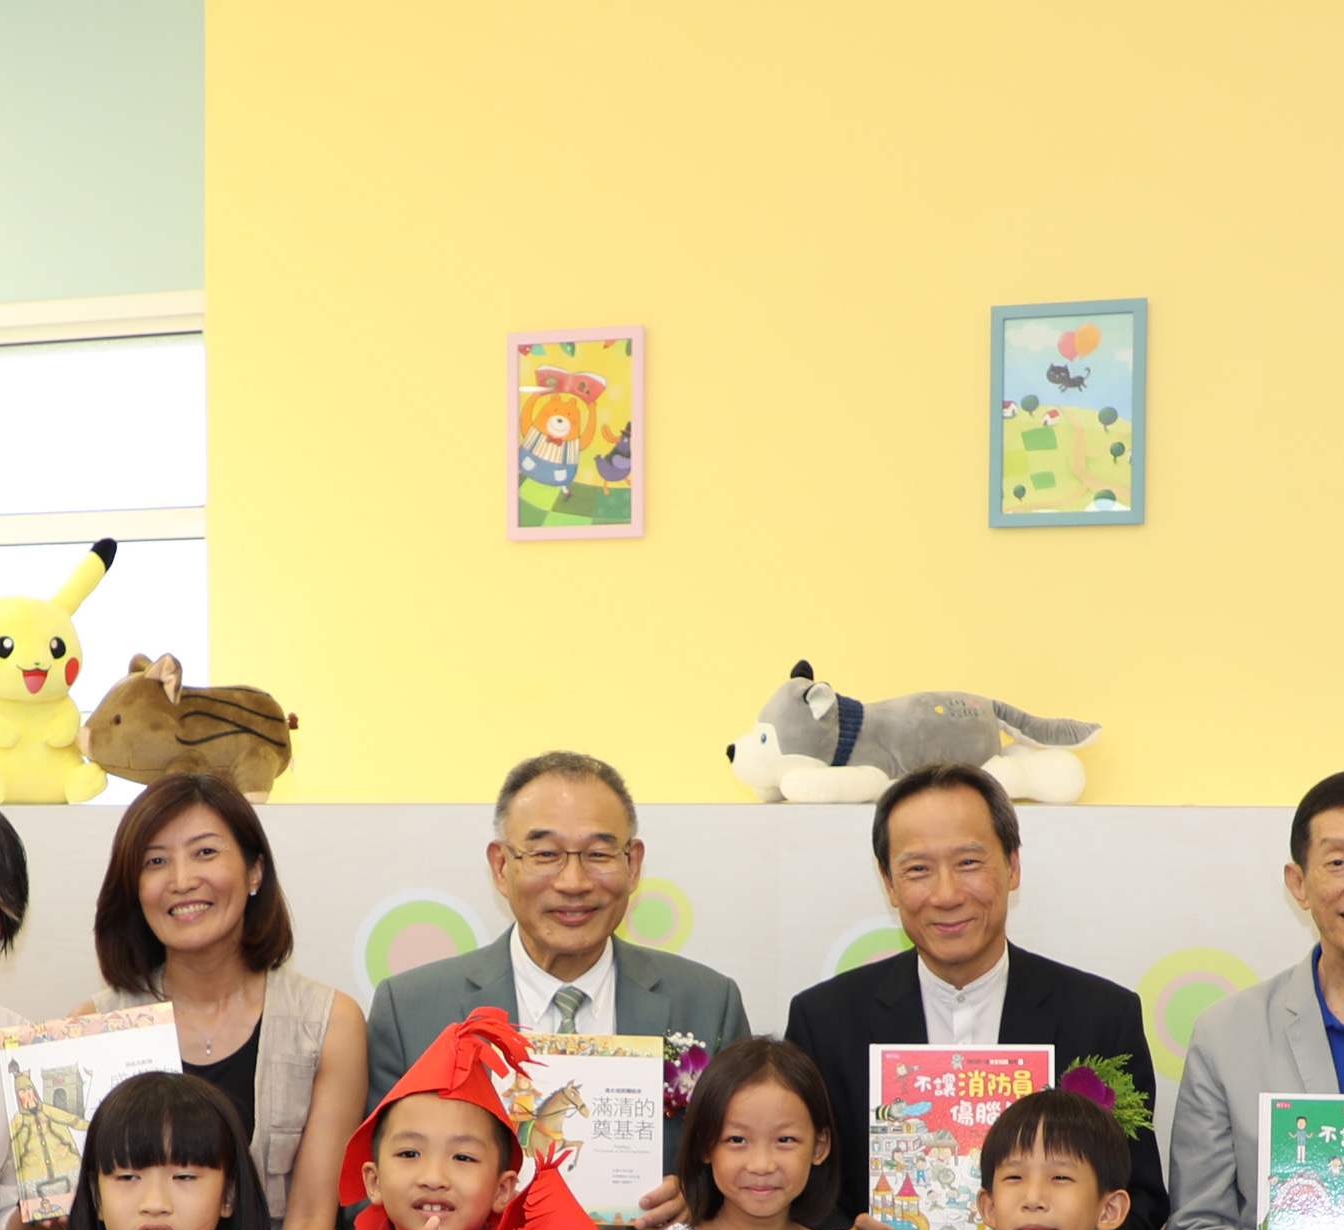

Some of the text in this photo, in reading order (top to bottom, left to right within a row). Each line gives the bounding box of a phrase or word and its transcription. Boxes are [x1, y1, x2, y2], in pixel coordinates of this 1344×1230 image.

[592, 1096, 655, 1119] 滿清的
[950, 1099, 1015, 1128] 傷腦
[592, 1120, 655, 1141] 奠基者
